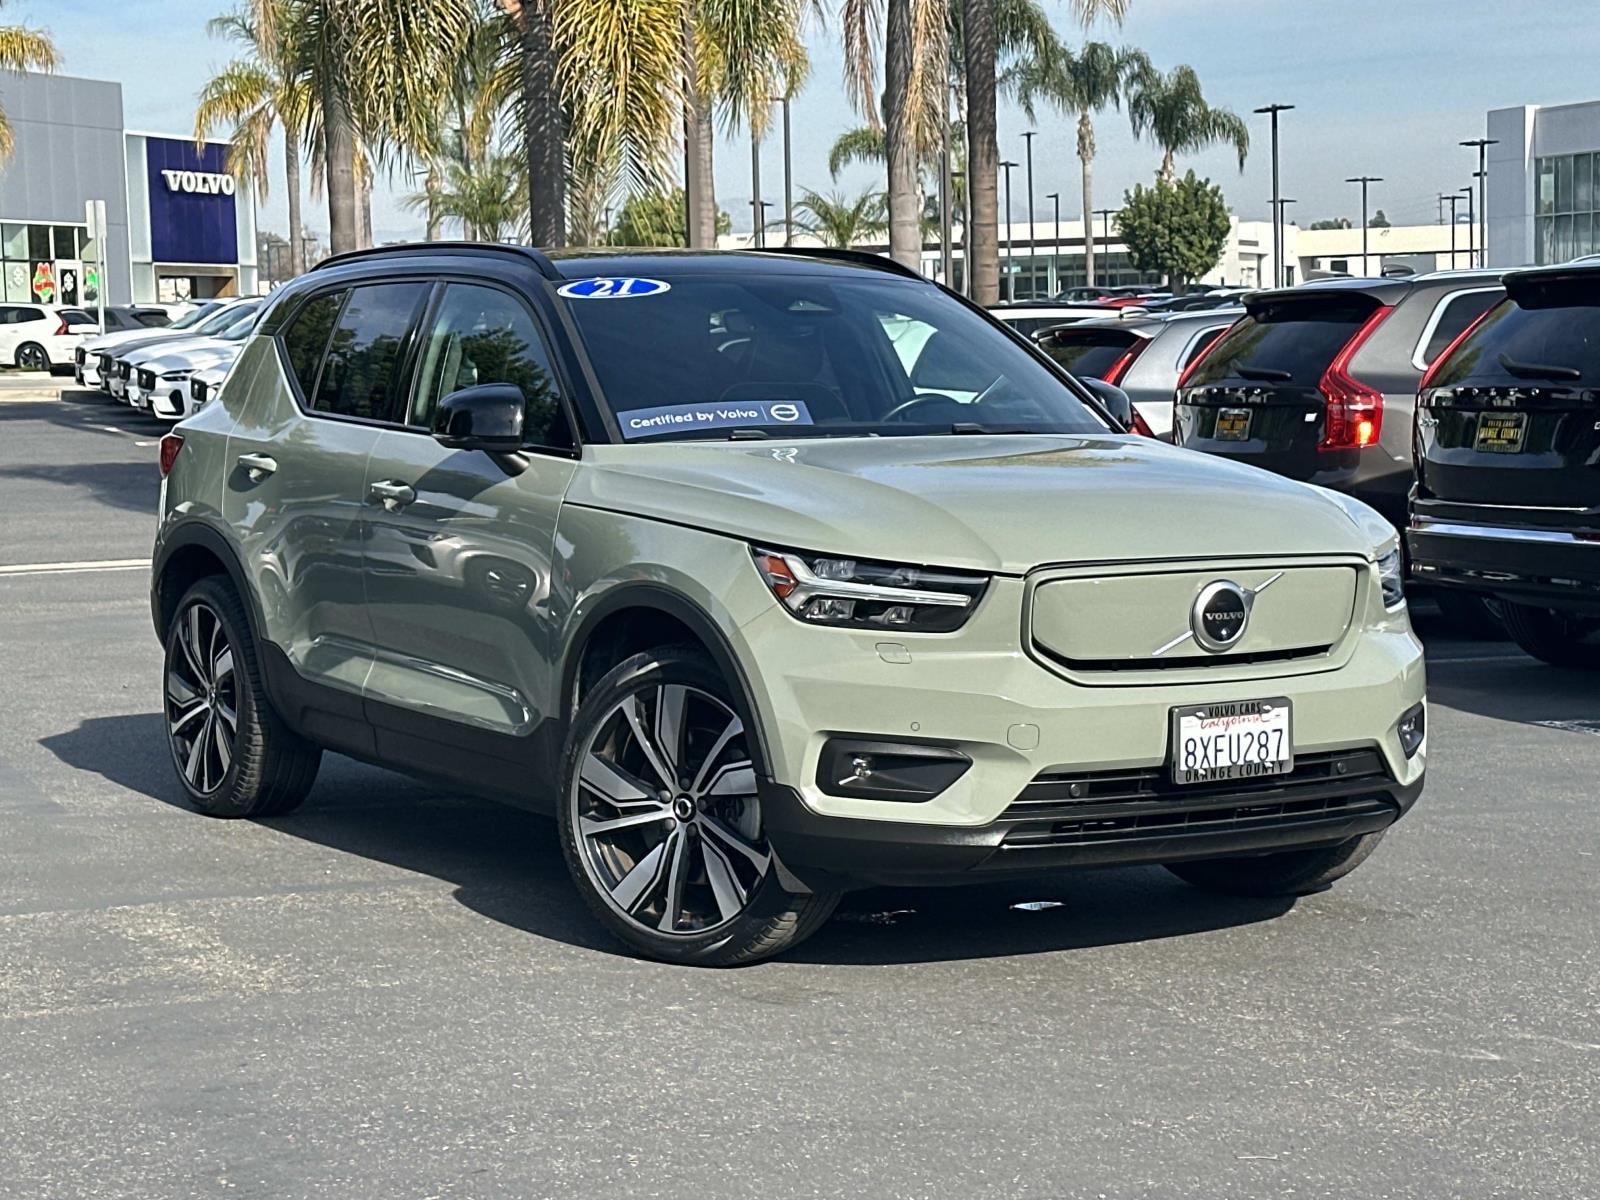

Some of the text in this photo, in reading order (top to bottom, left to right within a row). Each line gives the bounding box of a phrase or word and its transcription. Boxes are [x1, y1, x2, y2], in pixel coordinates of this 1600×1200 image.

[161, 169, 235, 196] VOLVO
[588, 279, 636, 297] 21
[630, 408, 758, 429] Certified by Volvo
[1205, 611, 1244, 621] VOLVO
[1208, 702, 1261, 718] VOLVO CARS
[1184, 728, 1283, 769] 8XFU287
[1185, 759, 1284, 782] ORANGE COUNTY
